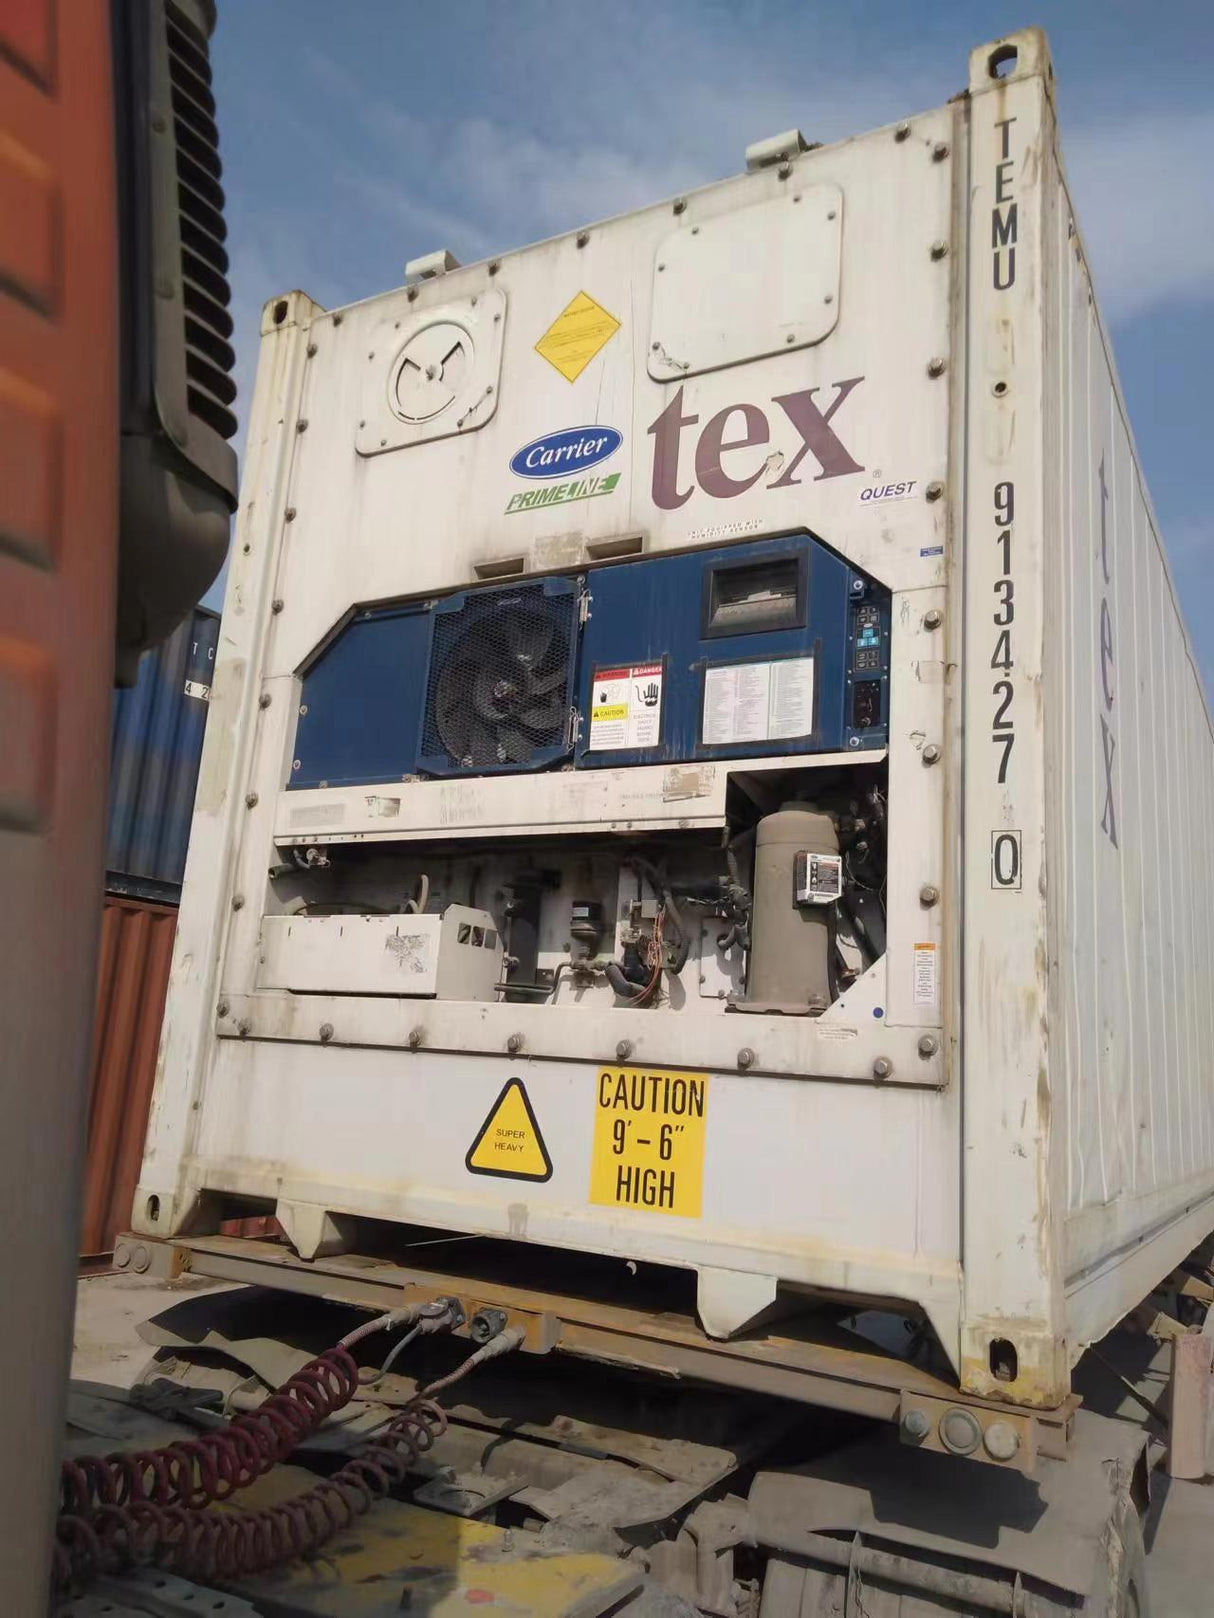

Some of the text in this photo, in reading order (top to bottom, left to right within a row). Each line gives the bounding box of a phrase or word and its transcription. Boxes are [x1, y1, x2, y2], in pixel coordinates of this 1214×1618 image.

[991, 117, 1018, 290] TEMU
[525, 437, 608, 468] Carrier
[646, 376, 865, 510] tex
[860, 481, 917, 501] QUEST
[991, 481, 1015, 784] 913427
[994, 834, 1018, 887] 0
[599, 1073, 705, 1118] CAUTION
[494, 1142, 524, 1153] HEAVY
[496, 1128, 525, 1139] SUPER
[616, 1165, 675, 1209] HIGH
